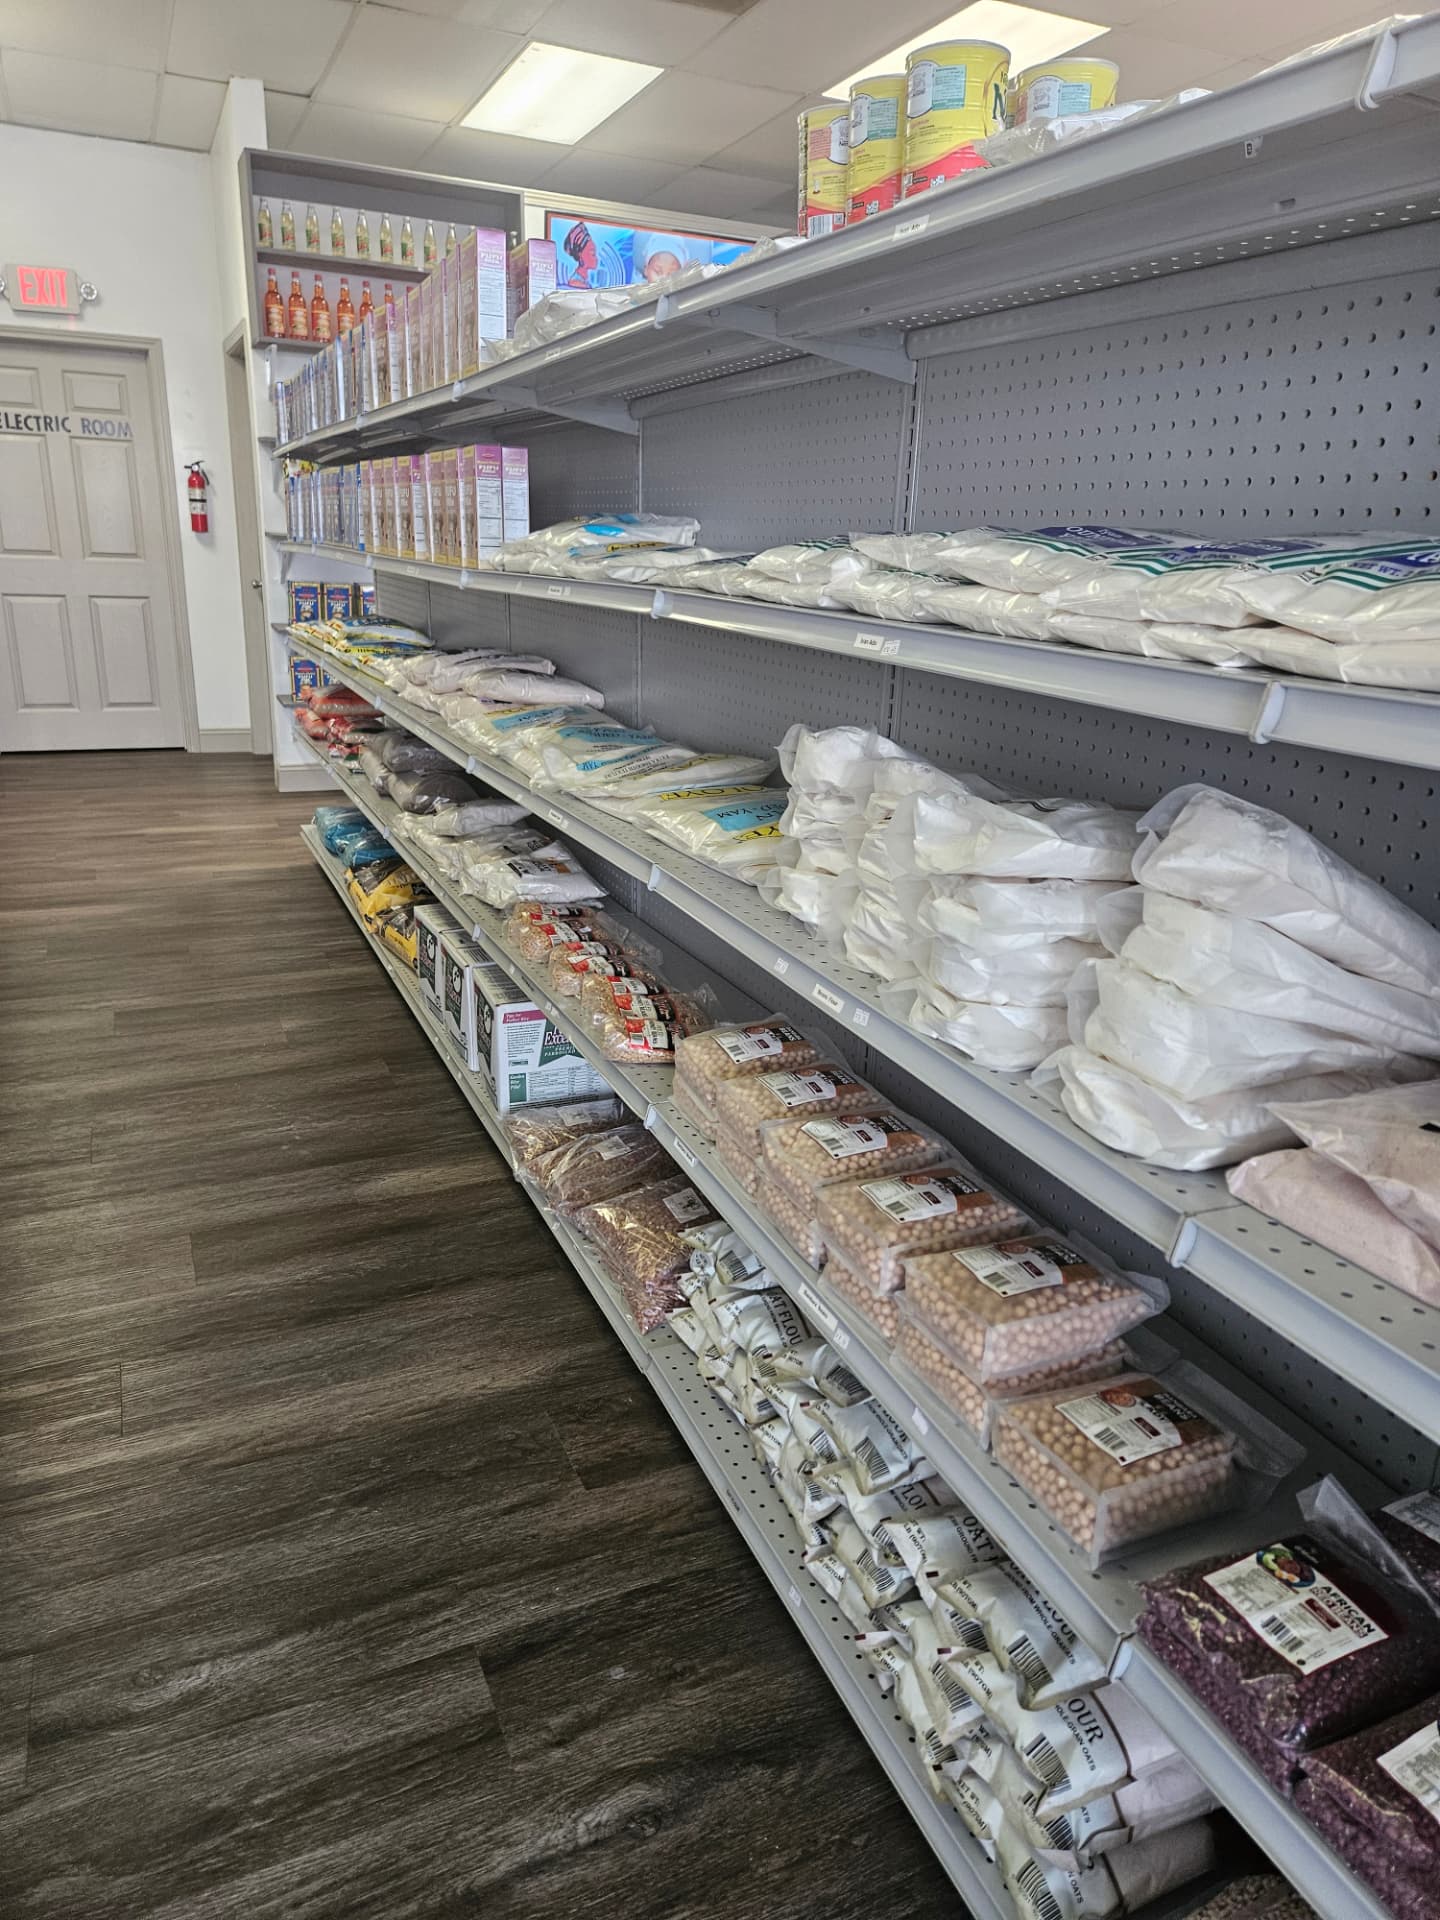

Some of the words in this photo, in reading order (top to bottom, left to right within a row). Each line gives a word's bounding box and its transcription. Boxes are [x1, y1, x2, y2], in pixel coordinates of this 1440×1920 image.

[17, 265, 68, 308] EXIT
[81, 418, 133, 438] ROOM
[778, 1309, 804, 1346] FLOU
[962, 1514, 995, 1556] OAT
[1321, 1585, 1376, 1634] AFRICAN
[1067, 1698, 1104, 1745] OUR
[1077, 1746, 1099, 1772] OATS
[1065, 1877, 1087, 1905] OATS
